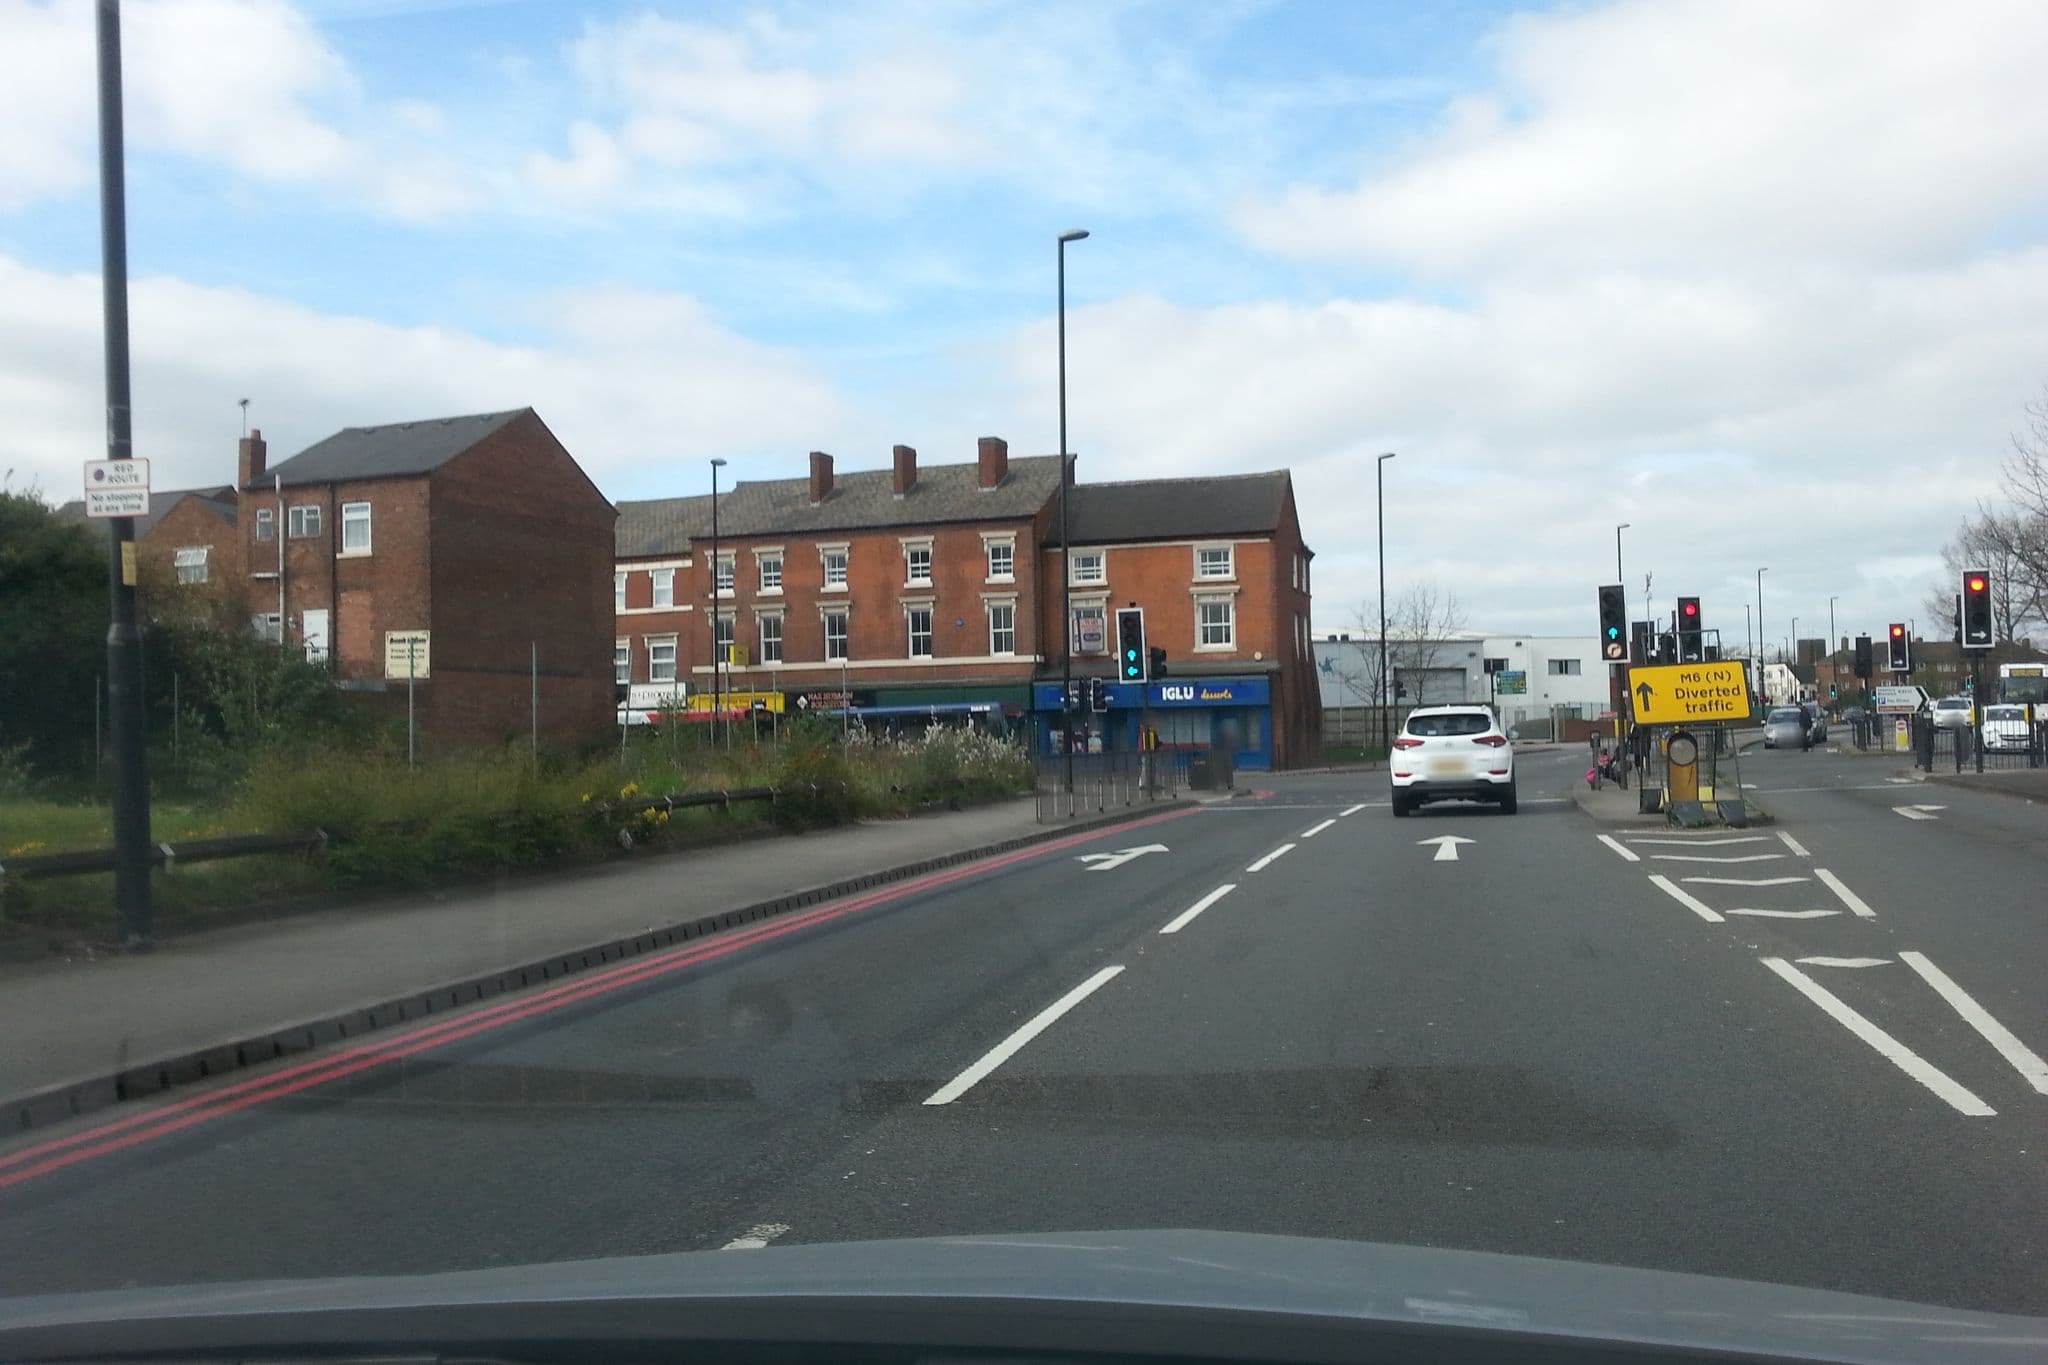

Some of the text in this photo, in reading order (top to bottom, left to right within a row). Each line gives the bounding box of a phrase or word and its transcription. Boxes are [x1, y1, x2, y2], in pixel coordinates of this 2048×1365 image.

[113, 463, 134, 472] RED
[108, 474, 139, 483] ROUTE
[91, 493, 144, 503] No stopping
[105, 505, 120, 513] any
[122, 503, 142, 511] time
[1680, 671, 1732, 683] M6 (N)
[1162, 686, 1233, 701] IGLU desserts
[1675, 684, 1741, 700] Diverted
[1685, 700, 1734, 713] traffic
